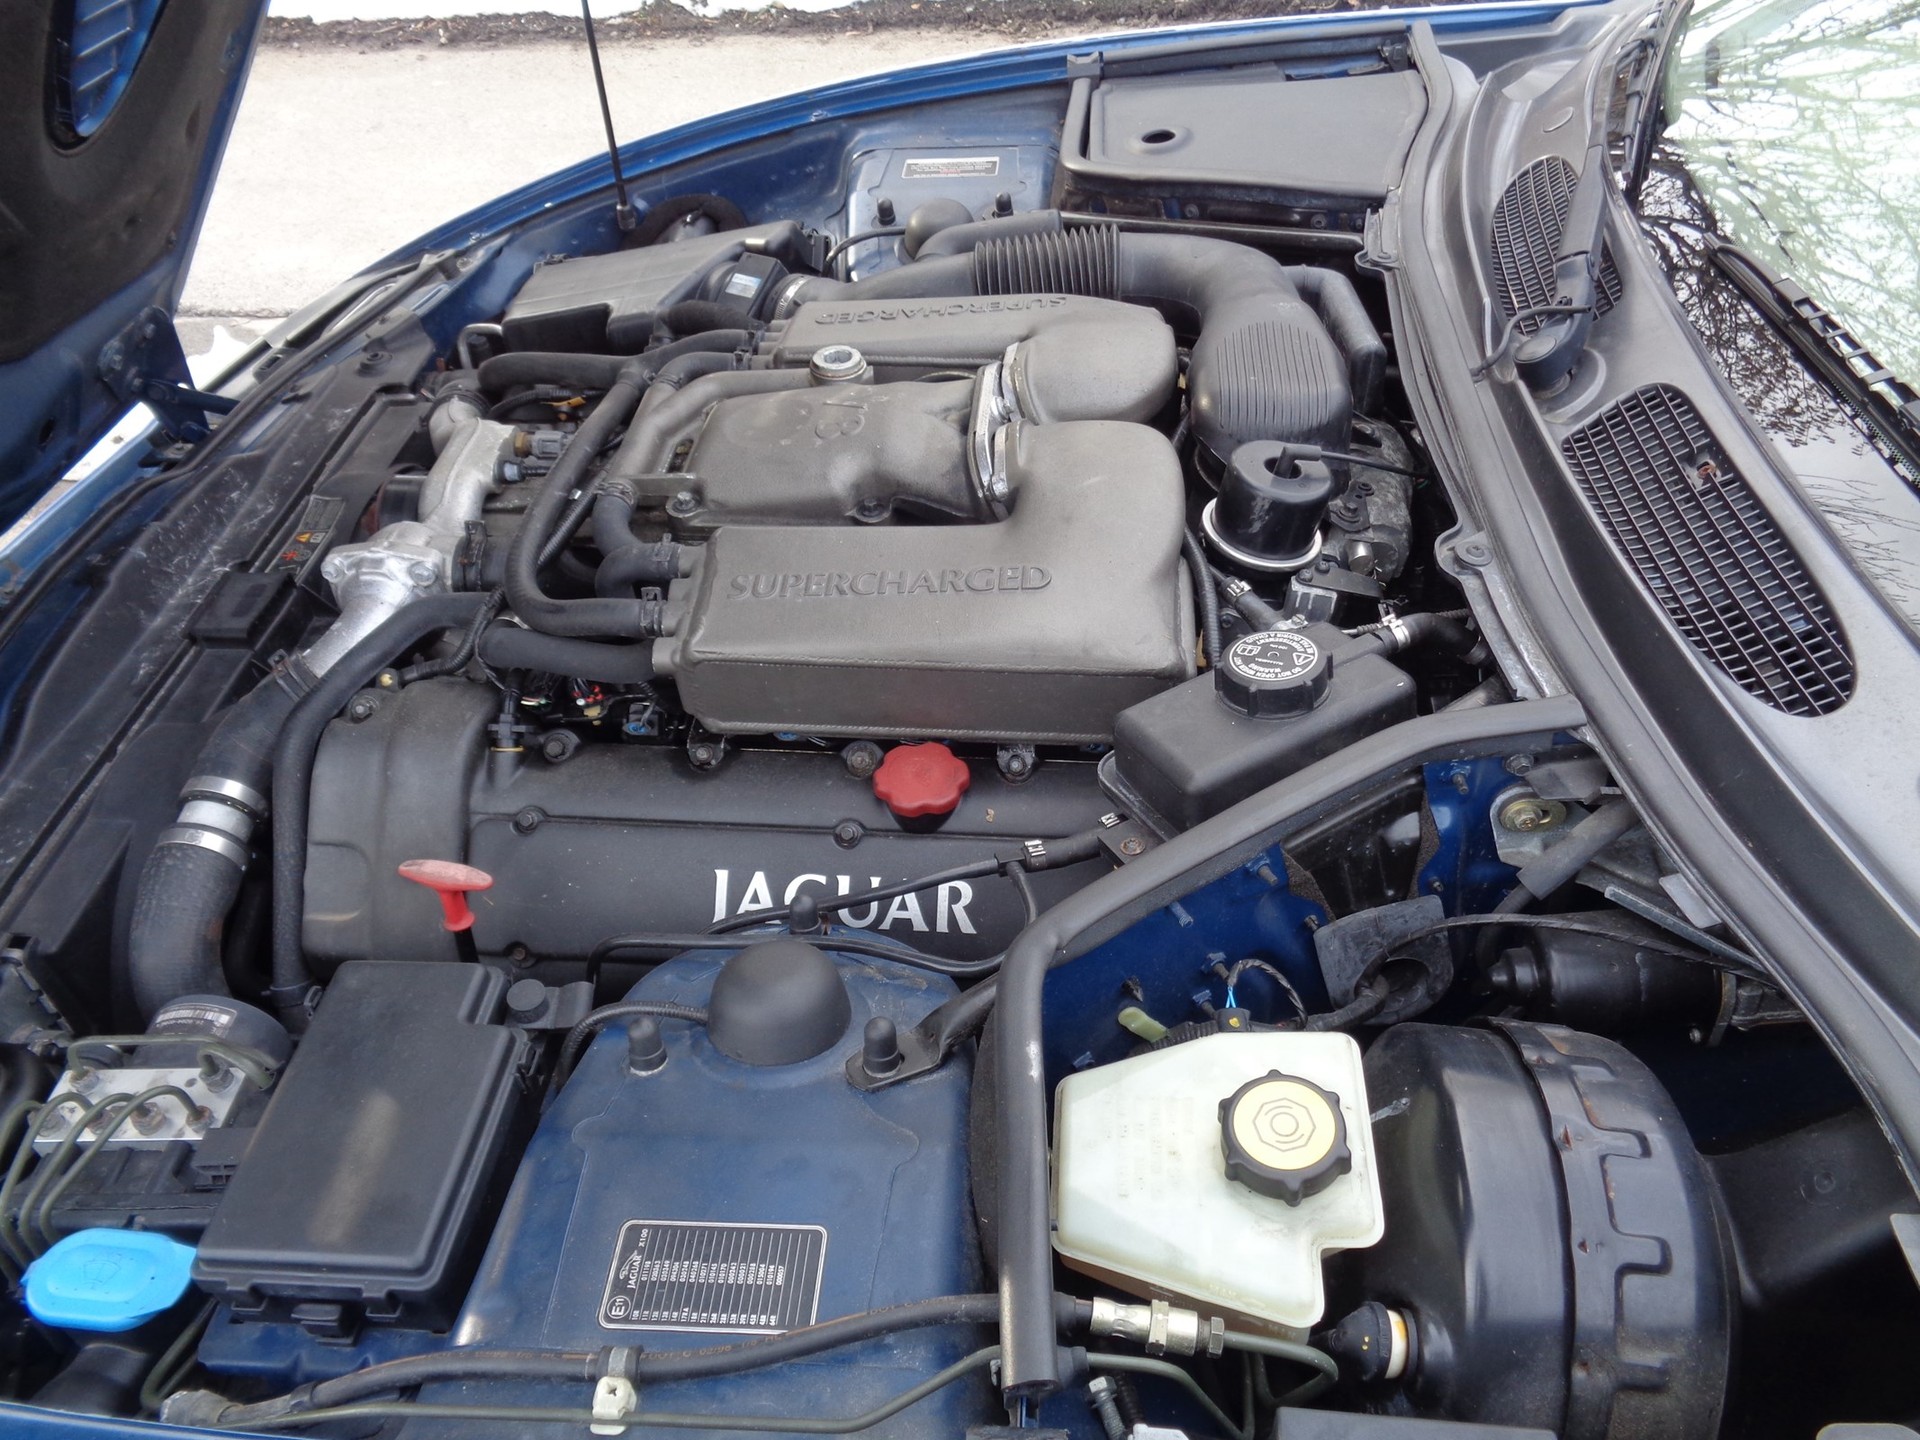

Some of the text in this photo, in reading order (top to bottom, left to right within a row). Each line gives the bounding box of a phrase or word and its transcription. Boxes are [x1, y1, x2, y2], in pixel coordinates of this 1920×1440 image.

[815, 297, 1067, 325] SUPERCHARGED
[727, 564, 1052, 601] SUPERCHARGED
[1248, 663, 1281, 673] WARNING
[638, 1229, 648, 1247] X100
[627, 1255, 642, 1289] JAGUAR
[632, 1310, 640, 1320] 10R
[651, 1311, 659, 1321] 12R
